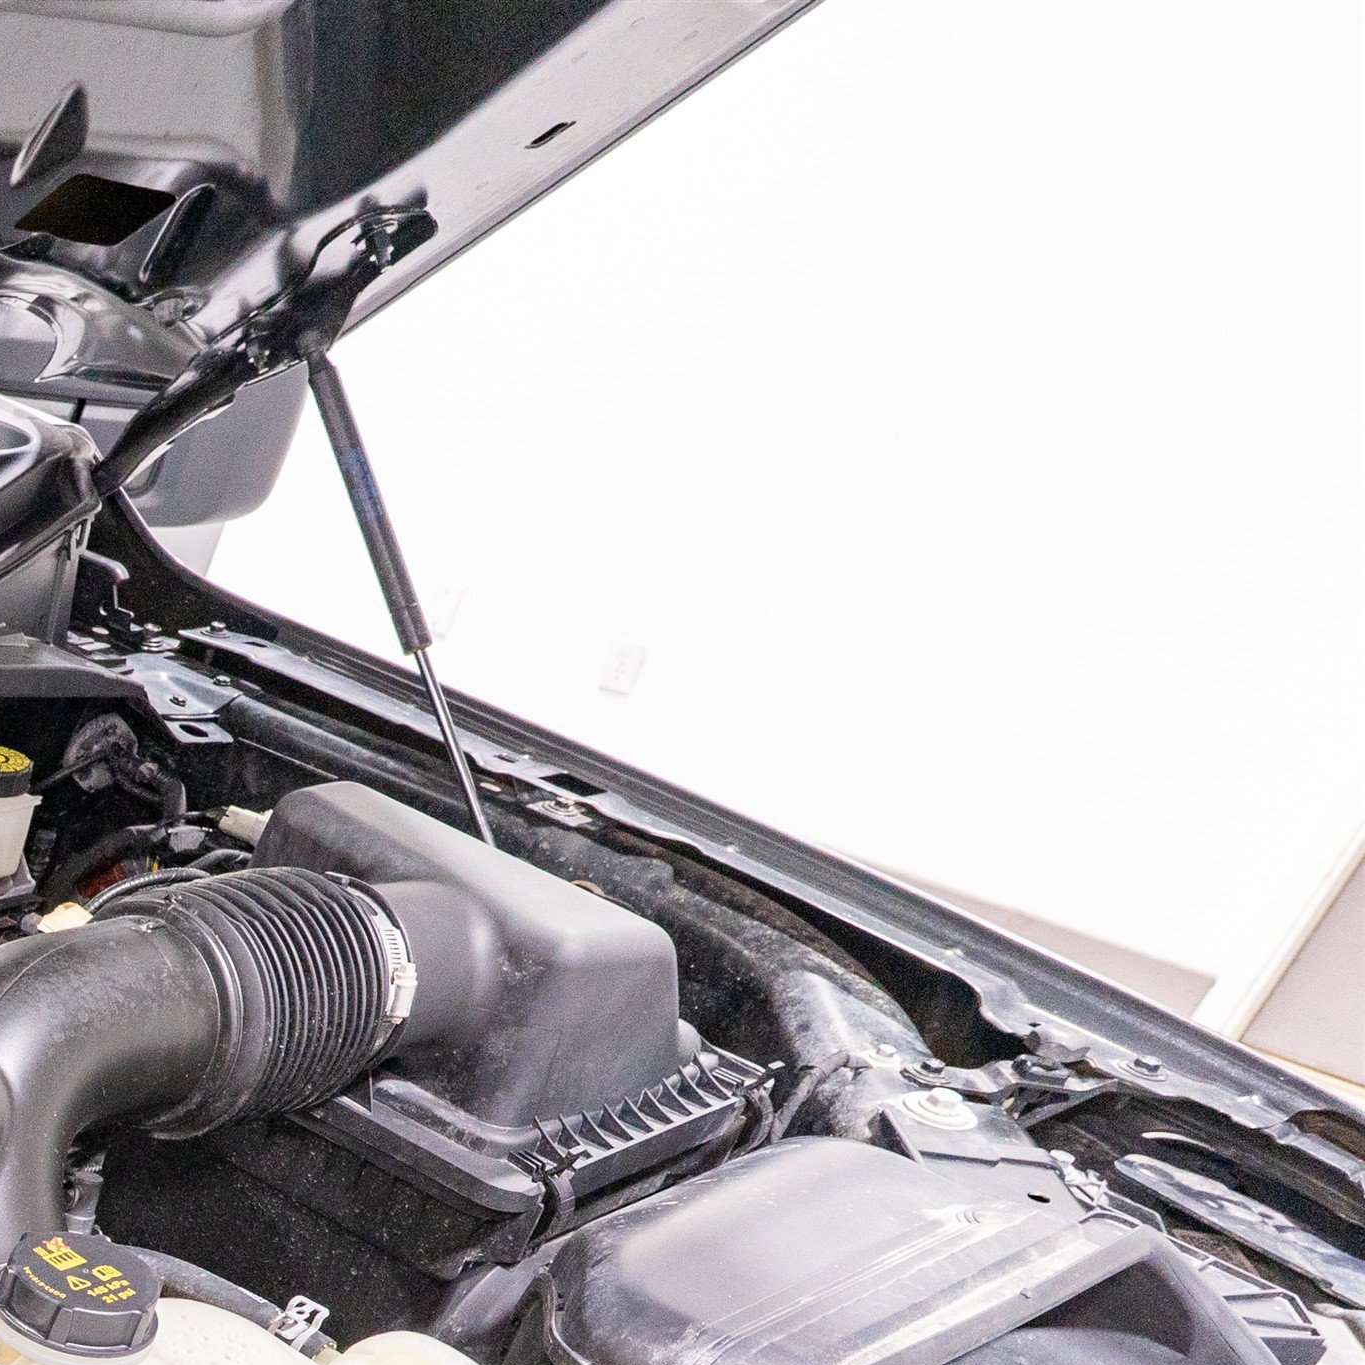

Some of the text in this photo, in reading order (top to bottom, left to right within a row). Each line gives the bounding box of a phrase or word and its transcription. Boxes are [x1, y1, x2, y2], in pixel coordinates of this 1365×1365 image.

[87, 1279, 131, 1298] 145 kPa
[101, 1288, 137, 1304] 21 psi
